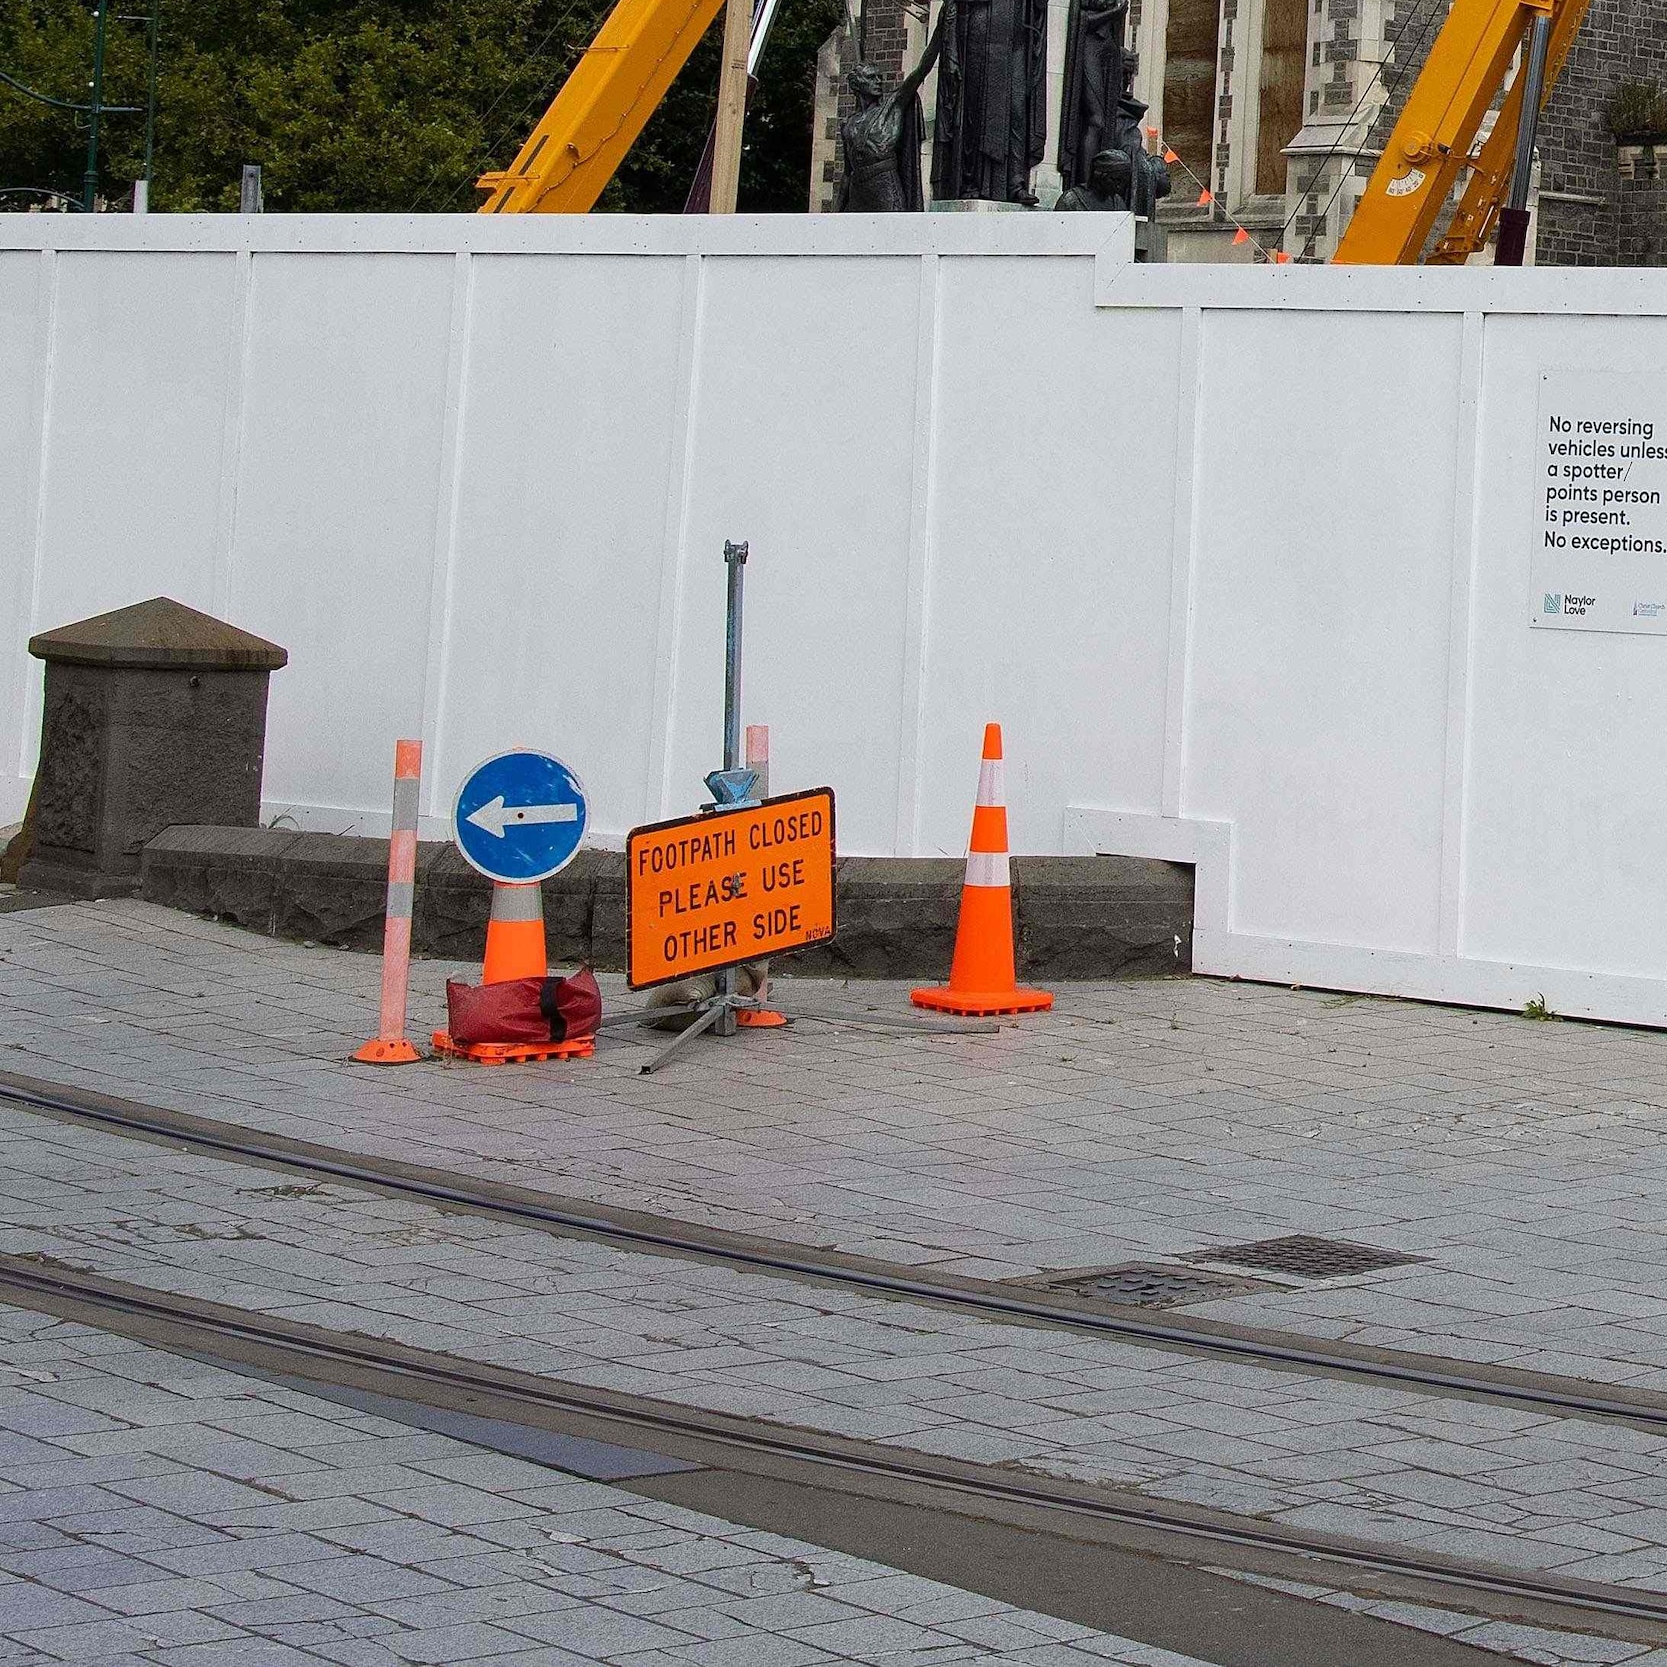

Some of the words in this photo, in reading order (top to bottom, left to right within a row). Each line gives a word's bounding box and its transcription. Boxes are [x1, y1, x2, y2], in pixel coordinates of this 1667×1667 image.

[1550, 416, 1572, 432] No
[1576, 418, 1654, 440] reversing
[1548, 439, 1615, 457] vehicles
[1547, 464, 1558, 477] a
[1563, 461, 1633, 482] spotter/
[1546, 484, 1598, 503] points
[1602, 488, 1660, 506] person
[1545, 505, 1558, 522] is
[1562, 509, 1630, 526] present.
[1544, 531, 1566, 548] No
[1571, 534, 1667, 555] exceptions.
[1564, 594, 1596, 608] Naylor
[1564, 604, 1586, 616] Love
[639, 829, 736, 877] FOOTPATH
[750, 810, 823, 851] CLOSED
[659, 872, 748, 918] PLEASE
[762, 859, 805, 892] USE
[664, 920, 737, 962] OTHER
[752, 904, 802, 940] SIDE
[805, 928, 831, 941] NOVA
